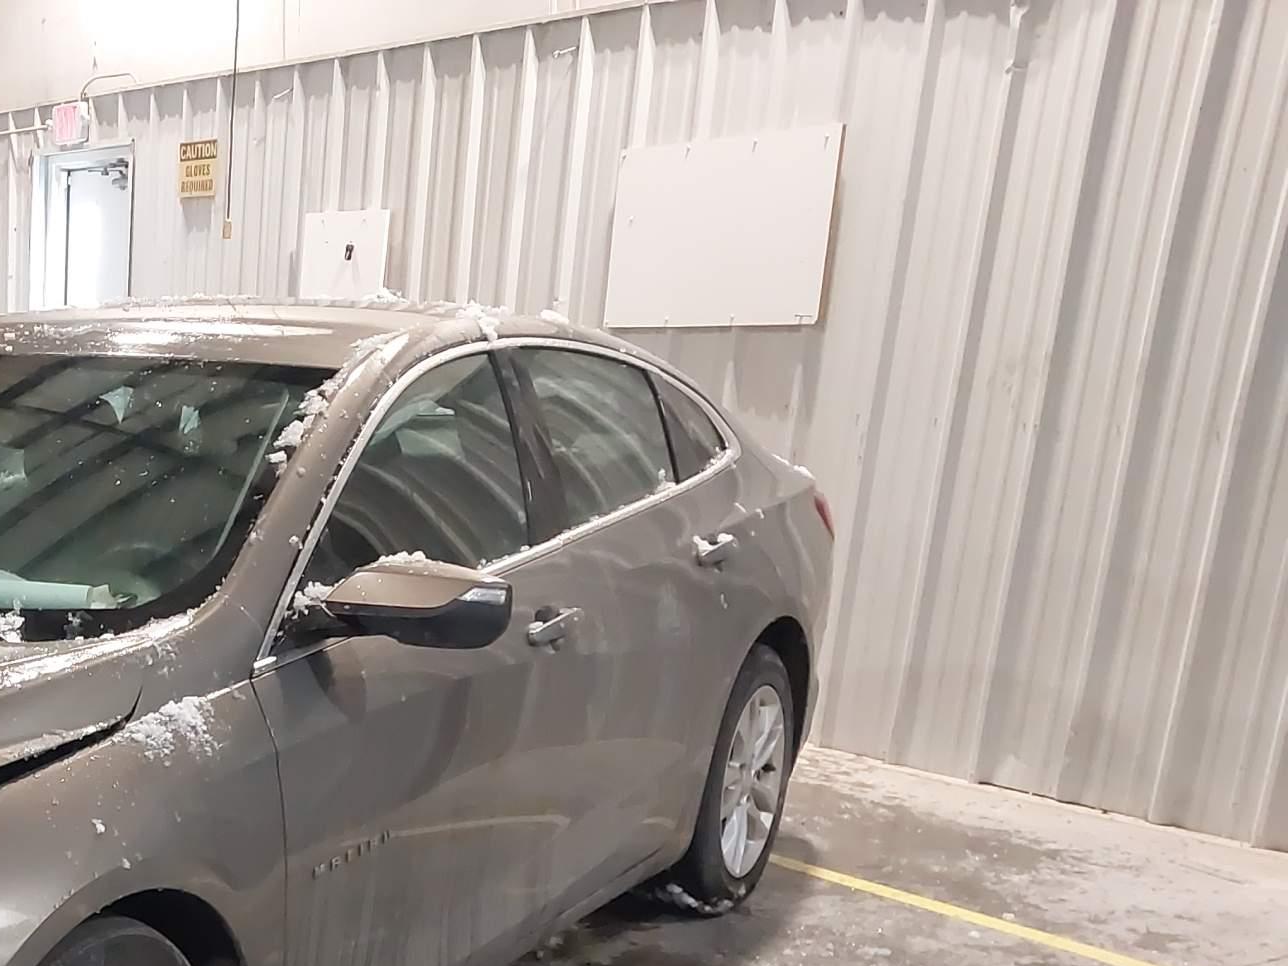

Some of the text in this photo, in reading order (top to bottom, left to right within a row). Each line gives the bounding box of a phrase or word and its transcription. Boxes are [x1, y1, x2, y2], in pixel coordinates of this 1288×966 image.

[181, 142, 217, 160] CAUTION
[185, 164, 211, 177] GLOVES
[181, 179, 213, 192] REQUIRED
